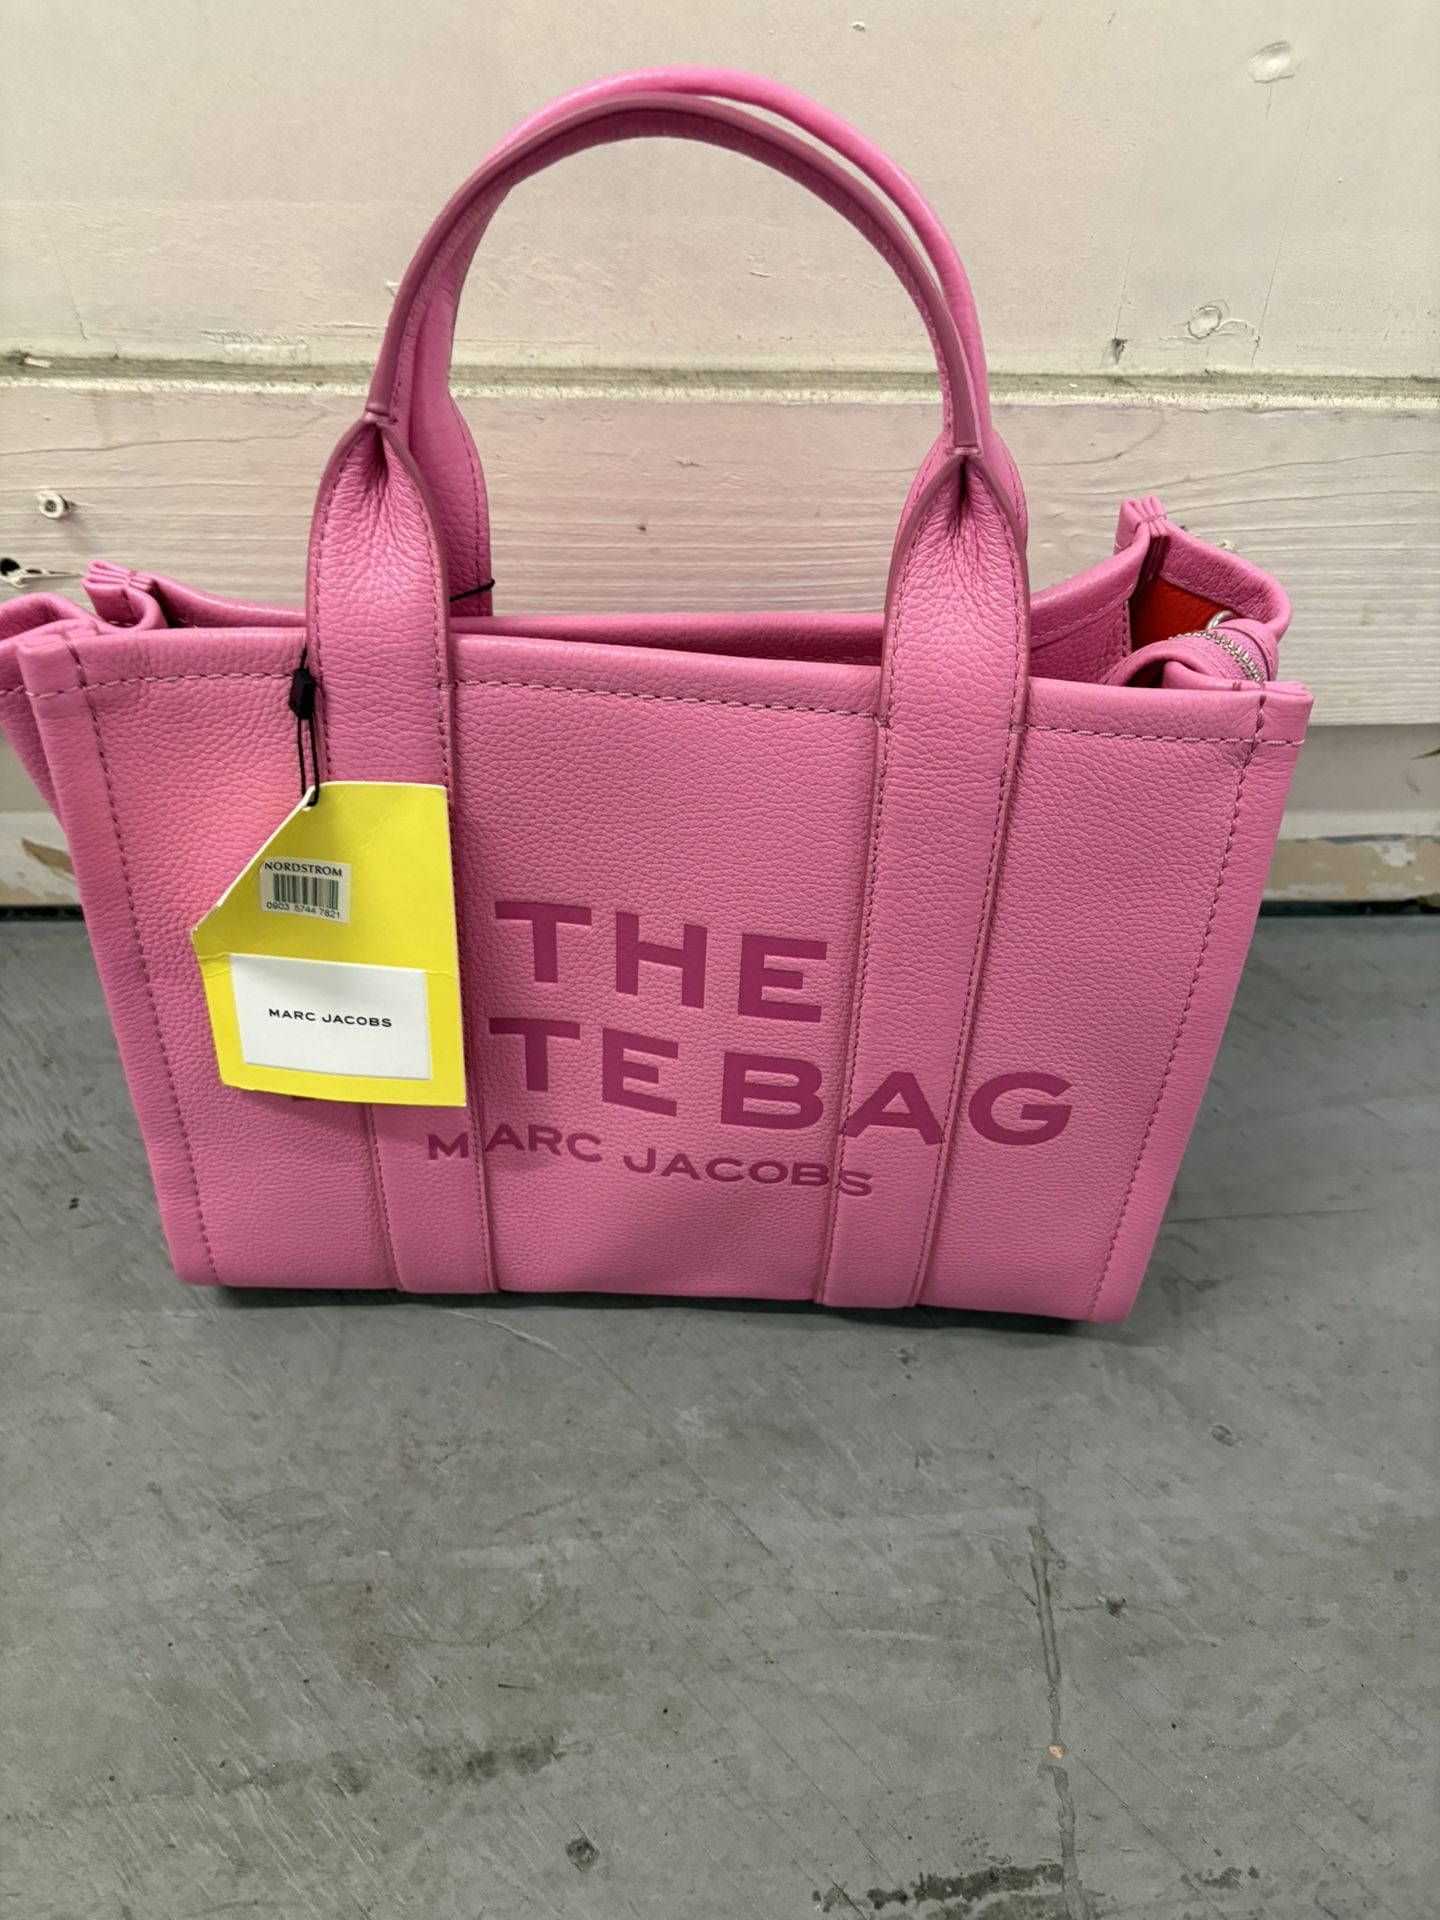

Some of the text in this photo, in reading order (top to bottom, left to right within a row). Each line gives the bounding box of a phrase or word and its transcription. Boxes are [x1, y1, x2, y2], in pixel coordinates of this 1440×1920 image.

[264, 861, 343, 877] NORDSTROM
[319, 907, 341, 919] 7821
[495, 901, 828, 1022] THE
[268, 1007, 393, 1028] MARC JACOBS
[489, 1018, 1073, 1146] TE BAG
[427, 1124, 874, 1197] MARC JACOBS
